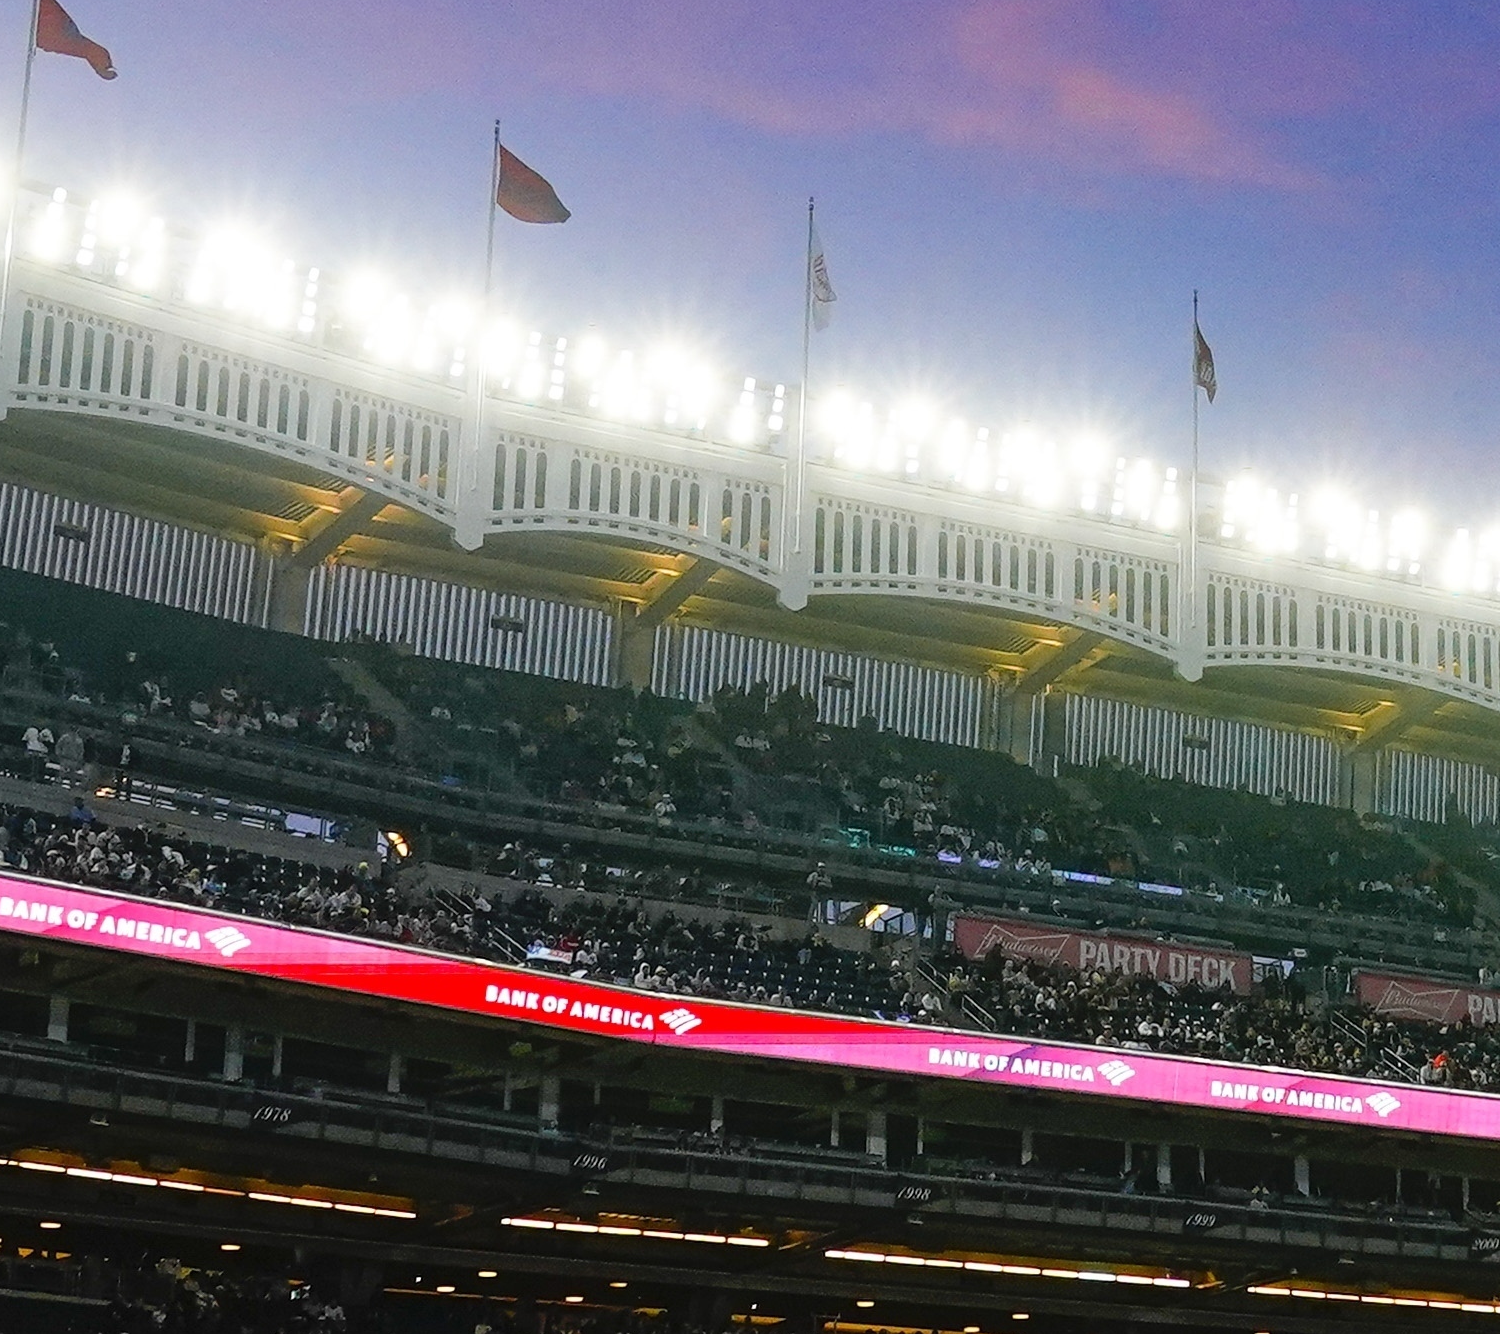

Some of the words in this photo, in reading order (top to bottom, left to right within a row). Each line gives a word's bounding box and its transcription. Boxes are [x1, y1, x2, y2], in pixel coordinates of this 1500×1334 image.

[66, 909, 99, 930] OF
[100, 915, 201, 949] AMERICA
[1079, 938, 1161, 978] PARTY
[1168, 951, 1238, 990] DECK
[485, 984, 539, 1010] BANK
[542, 995, 568, 1014] OF
[569, 1000, 654, 1030] AMERICA
[928, 1047, 980, 1068] BANK
[983, 1054, 1009, 1073] OF
[1010, 1057, 1095, 1083] AMERICA
[253, 1105, 292, 1122] 1978
[1210, 1080, 1259, 1102] BANK
[1261, 1086, 1285, 1104] OF
[1286, 1089, 1363, 1114] AMERICA
[573, 1154, 608, 1170] 1996
[897, 1186, 932, 1201] 1998
[1185, 1212, 1216, 1227] 1999
